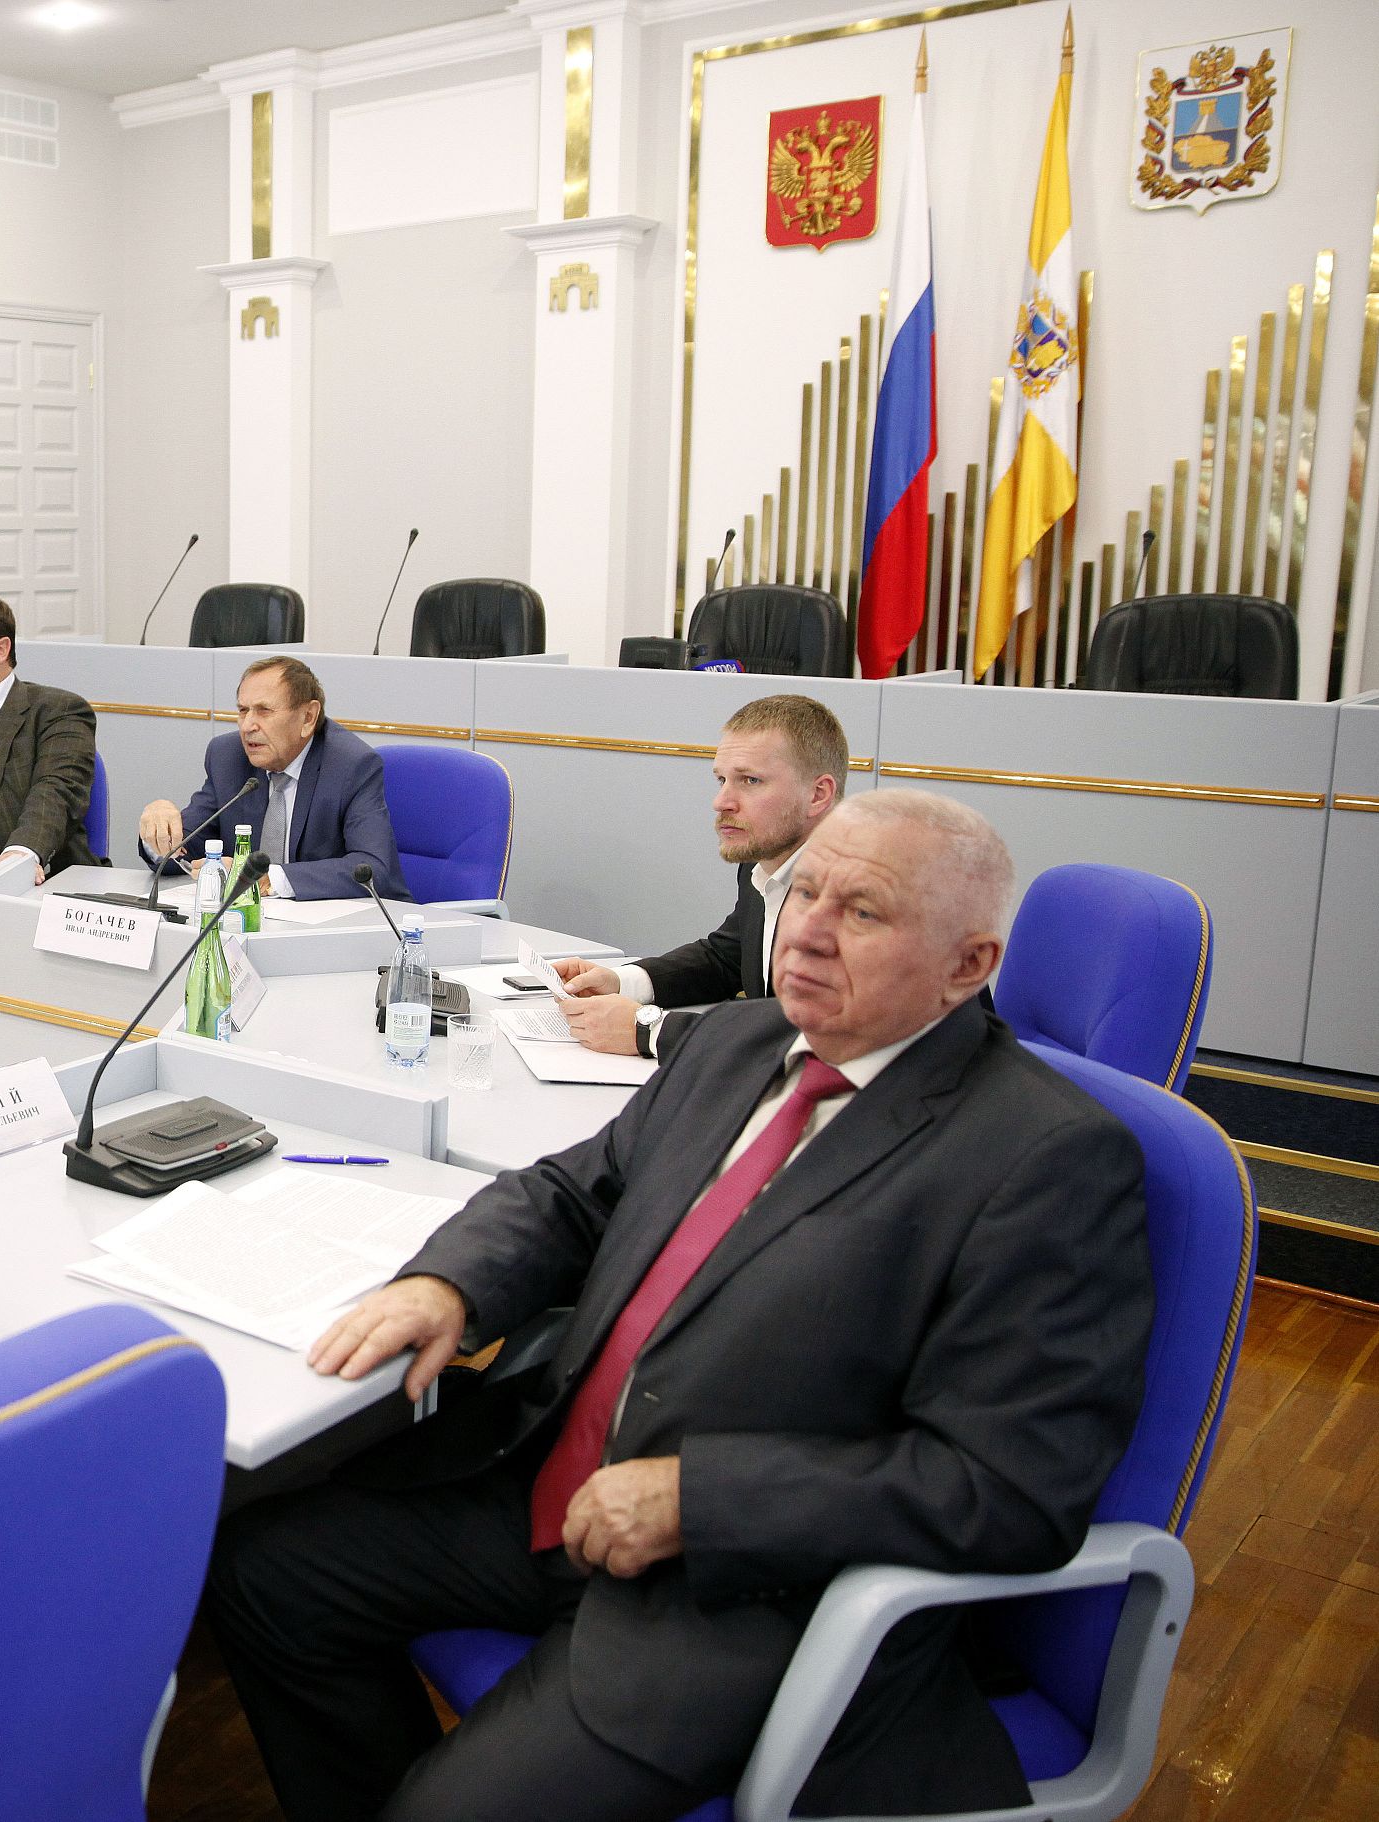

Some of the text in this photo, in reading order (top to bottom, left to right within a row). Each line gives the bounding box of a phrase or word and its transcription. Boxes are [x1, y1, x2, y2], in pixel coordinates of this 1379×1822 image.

[65, 908, 136, 931] БОГАЧЕВ
[65, 923, 131, 942] ИВАН АНДРЕЕВИЧ
